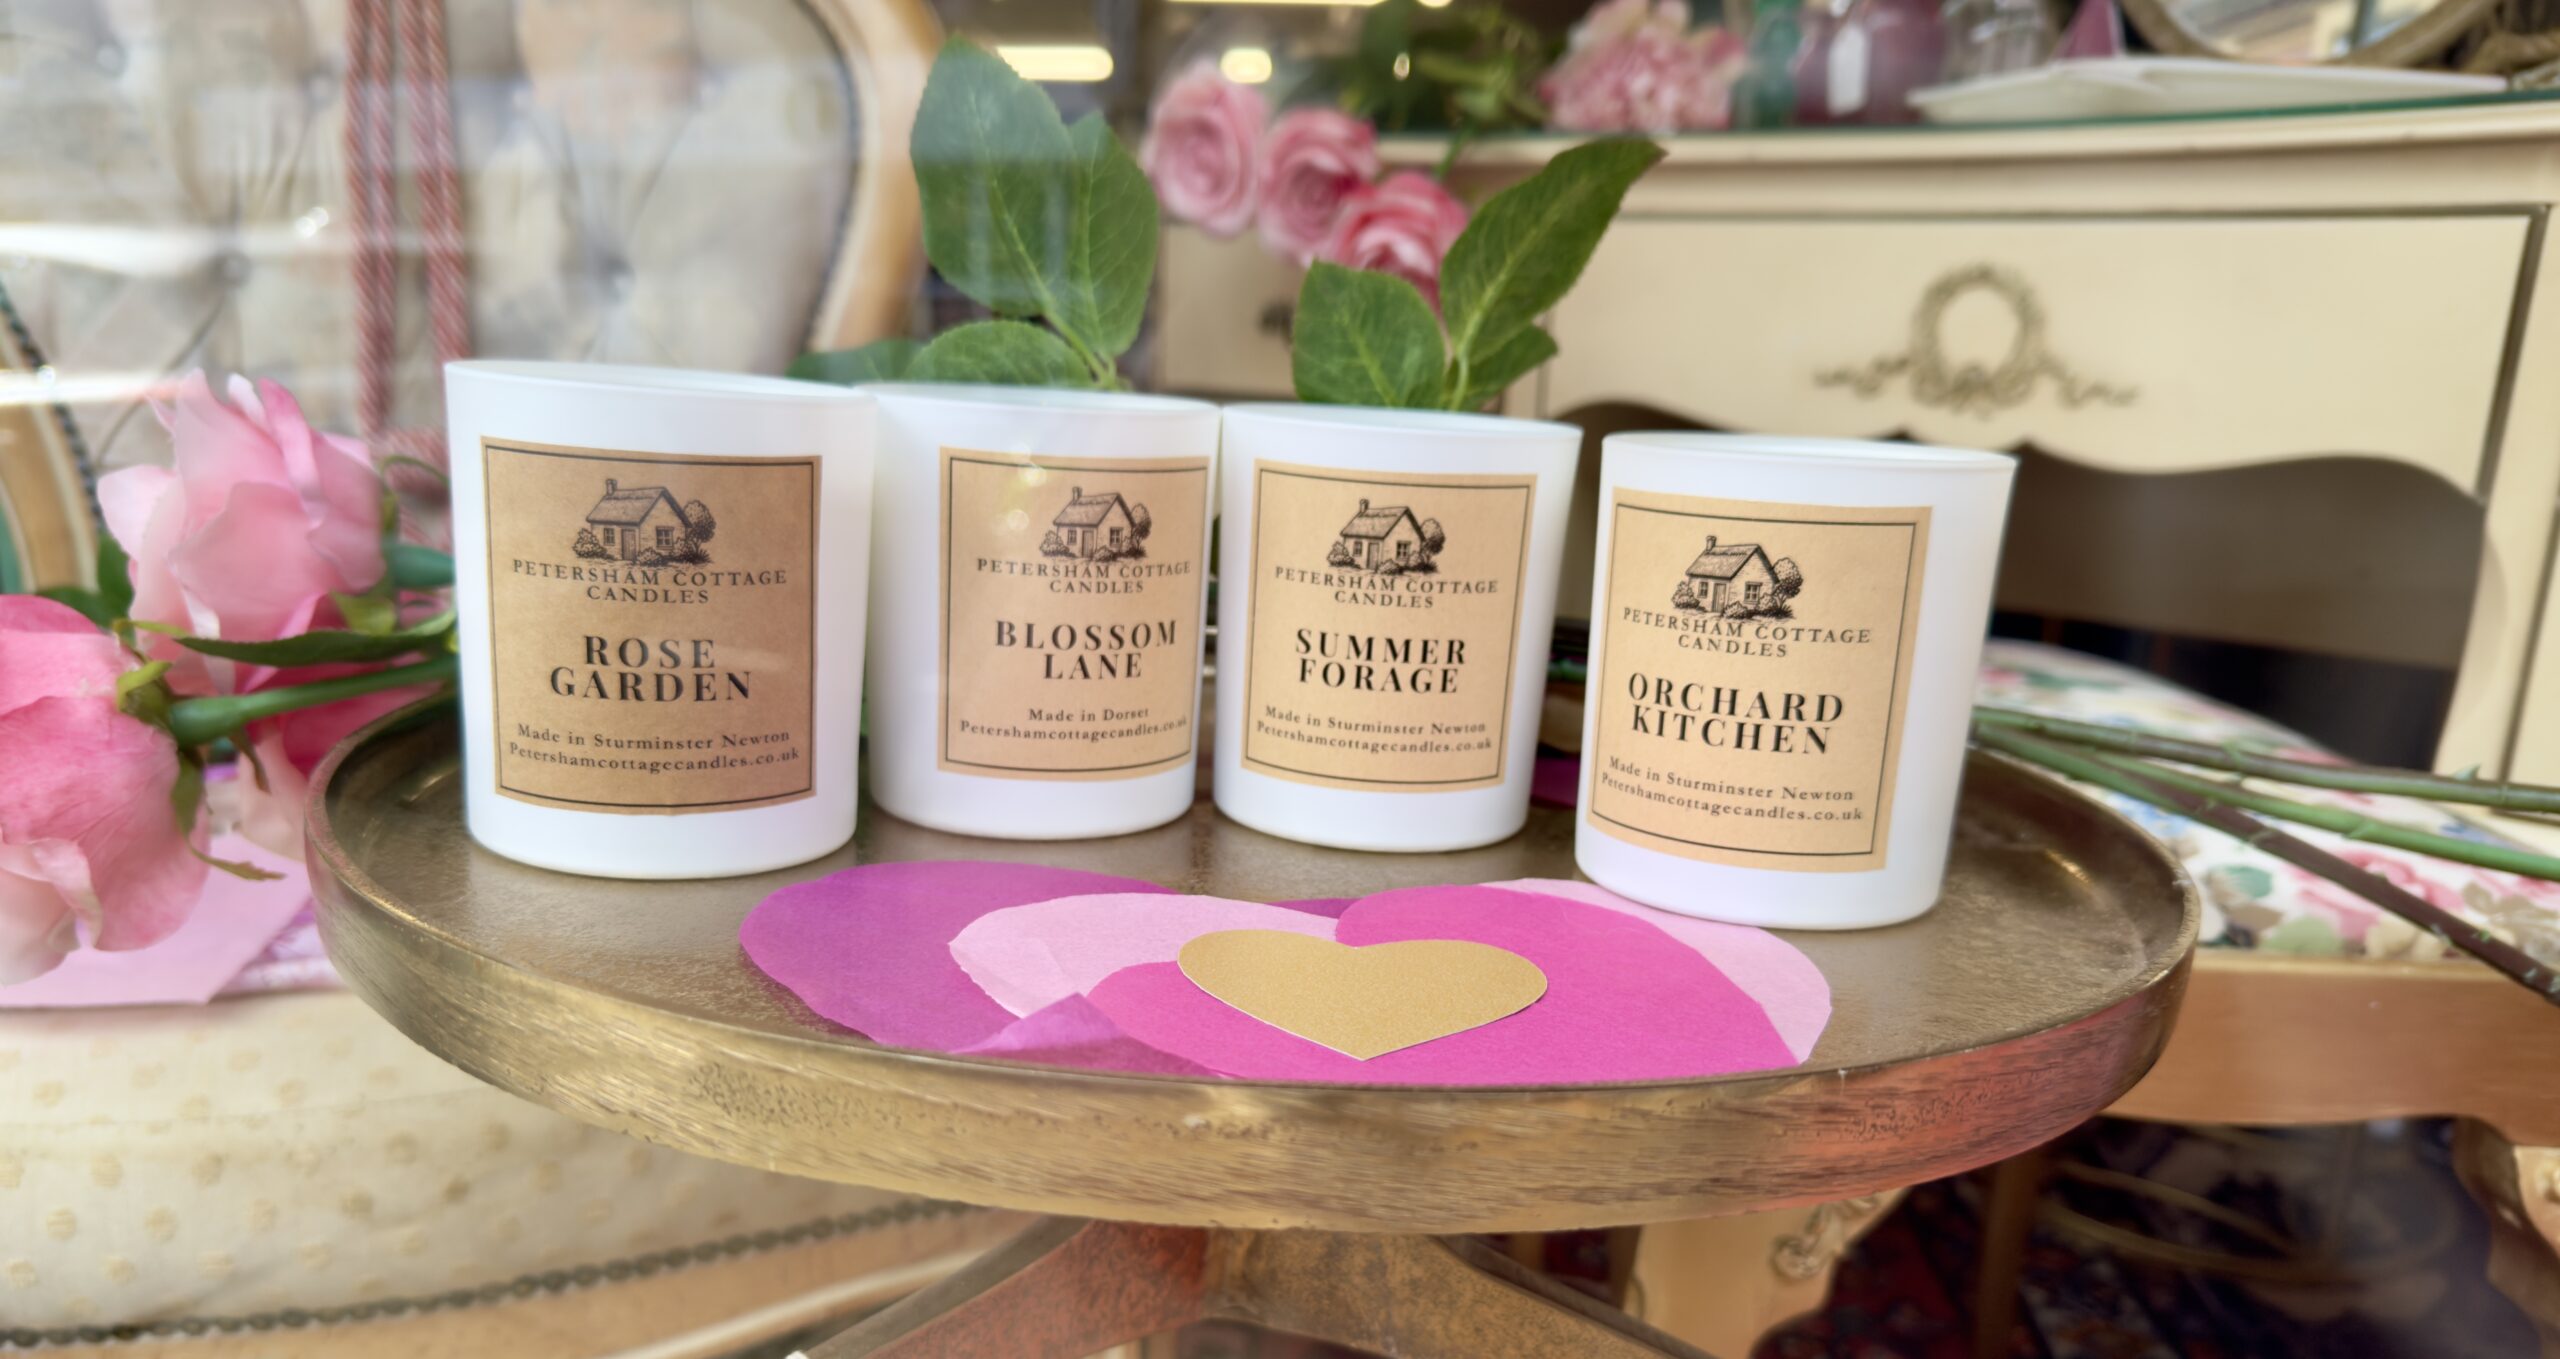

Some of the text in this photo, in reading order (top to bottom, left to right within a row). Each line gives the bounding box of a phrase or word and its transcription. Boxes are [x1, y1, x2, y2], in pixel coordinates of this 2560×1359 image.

[512, 558, 788, 587] PETERSHAM COTTAGE
[976, 558, 1192, 579] PETERSHAM COTTAGE
[1275, 566, 1499, 595] PETERSHAM COTTAGE
[586, 585, 710, 604] CANDLES
[1049, 580, 1145, 595] CANDLES
[1334, 590, 1435, 609] CANDLES
[995, 619, 1178, 651] BLOSSOM
[1623, 606, 1872, 644] PETERSHAM COTTAGE
[584, 635, 716, 670] ROSE
[1295, 628, 1466, 666] SUMMER
[1677, 634, 1788, 659] CANDLES
[1043, 652, 1143, 680] LANE
[1299, 657, 1459, 695] FORAGE
[550, 666, 752, 702] GARDEN
[1628, 672, 1844, 724] ORCHARD
[1028, 707, 1150, 723] Made in Dorset
[1265, 704, 1487, 736] Made in Sturminster Newton
[1631, 703, 1831, 756] KITCHEN
[517, 723, 790, 751] Made in Sturminster Newton
[1256, 720, 1493, 754] Petershamcottagecandles.co.uk
[509, 741, 800, 775] Petershamcottagecandles.co.uk
[1608, 755, 1854, 802] Made in Sturminster Newton
[1601, 771, 1864, 822] Petershamcottagecandles.co.uk
